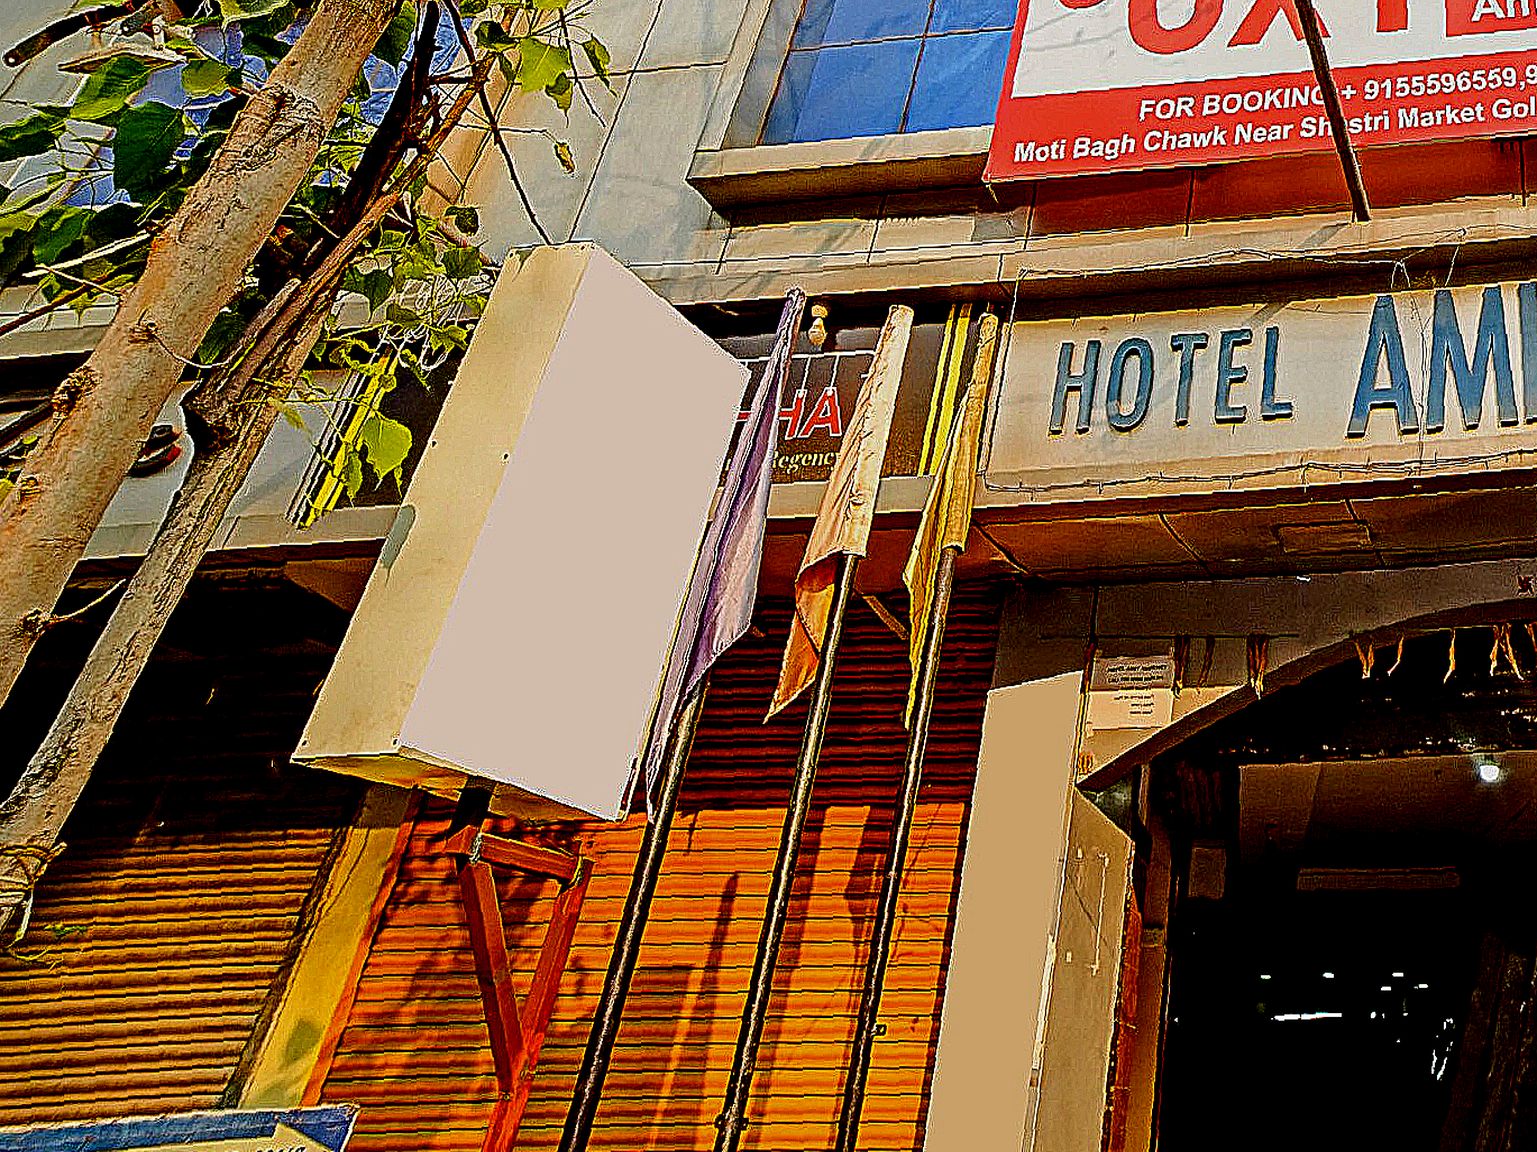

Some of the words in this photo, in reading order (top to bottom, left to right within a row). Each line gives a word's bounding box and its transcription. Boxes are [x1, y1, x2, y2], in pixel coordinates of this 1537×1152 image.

[1013, 139, 1066, 163] Moti
[1073, 135, 1134, 163] Bagh
[1143, 126, 1227, 152] Chawk
[1234, 122, 1292, 144] Near
[1299, 110, 1390, 138] Shstri
[1398, 103, 1485, 129] Market
[1492, 97, 1536, 120] Gol
[1139, 98, 1194, 122] FOR
[1048, 325, 1293, 434] HOTEL
